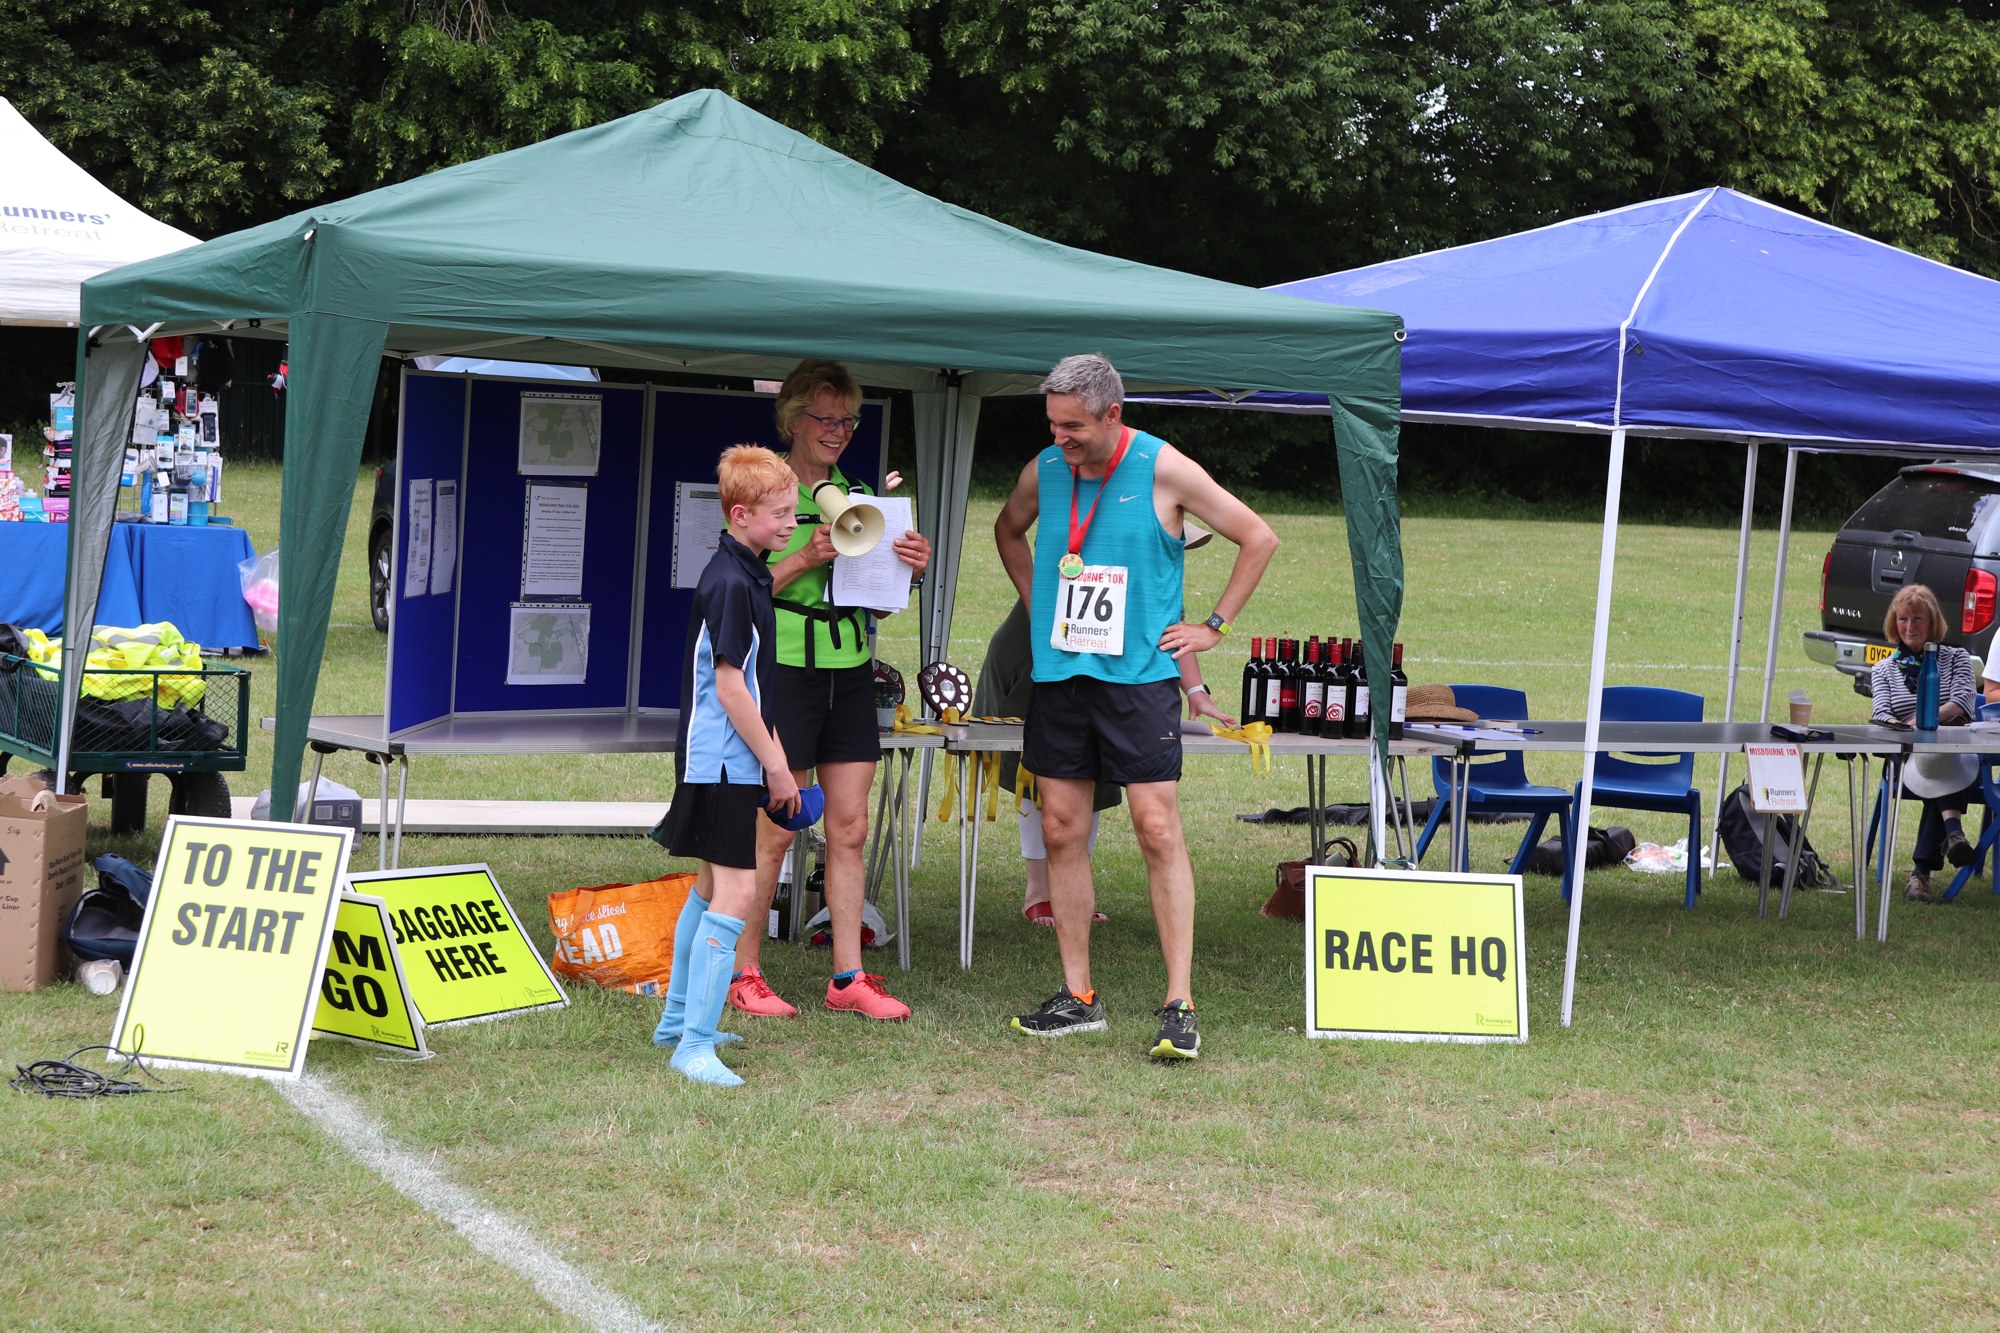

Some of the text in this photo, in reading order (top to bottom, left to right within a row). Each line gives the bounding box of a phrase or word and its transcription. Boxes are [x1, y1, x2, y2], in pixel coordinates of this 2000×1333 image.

[0, 206, 110, 225] unners'
[1108, 573, 1124, 584] 10K
[1066, 584, 1113, 622] 176
[1833, 607, 1861, 618] NAVARA
[1070, 624, 1112, 636] Runners'
[1070, 636, 1108, 648] Retreat
[1749, 747, 1798, 756] MISBOURNE 10K
[1770, 788, 1798, 797] Runners'
[1771, 798, 1799, 806] Retreat
[184, 842, 323, 895] TO THE
[5, 895, 19, 903] Cup
[597, 902, 627, 919] sliced
[172, 902, 305, 954] START
[425, 942, 507, 982] HERE
[1325, 929, 1507, 982] RACE HQ
[321, 968, 388, 1017] GO
